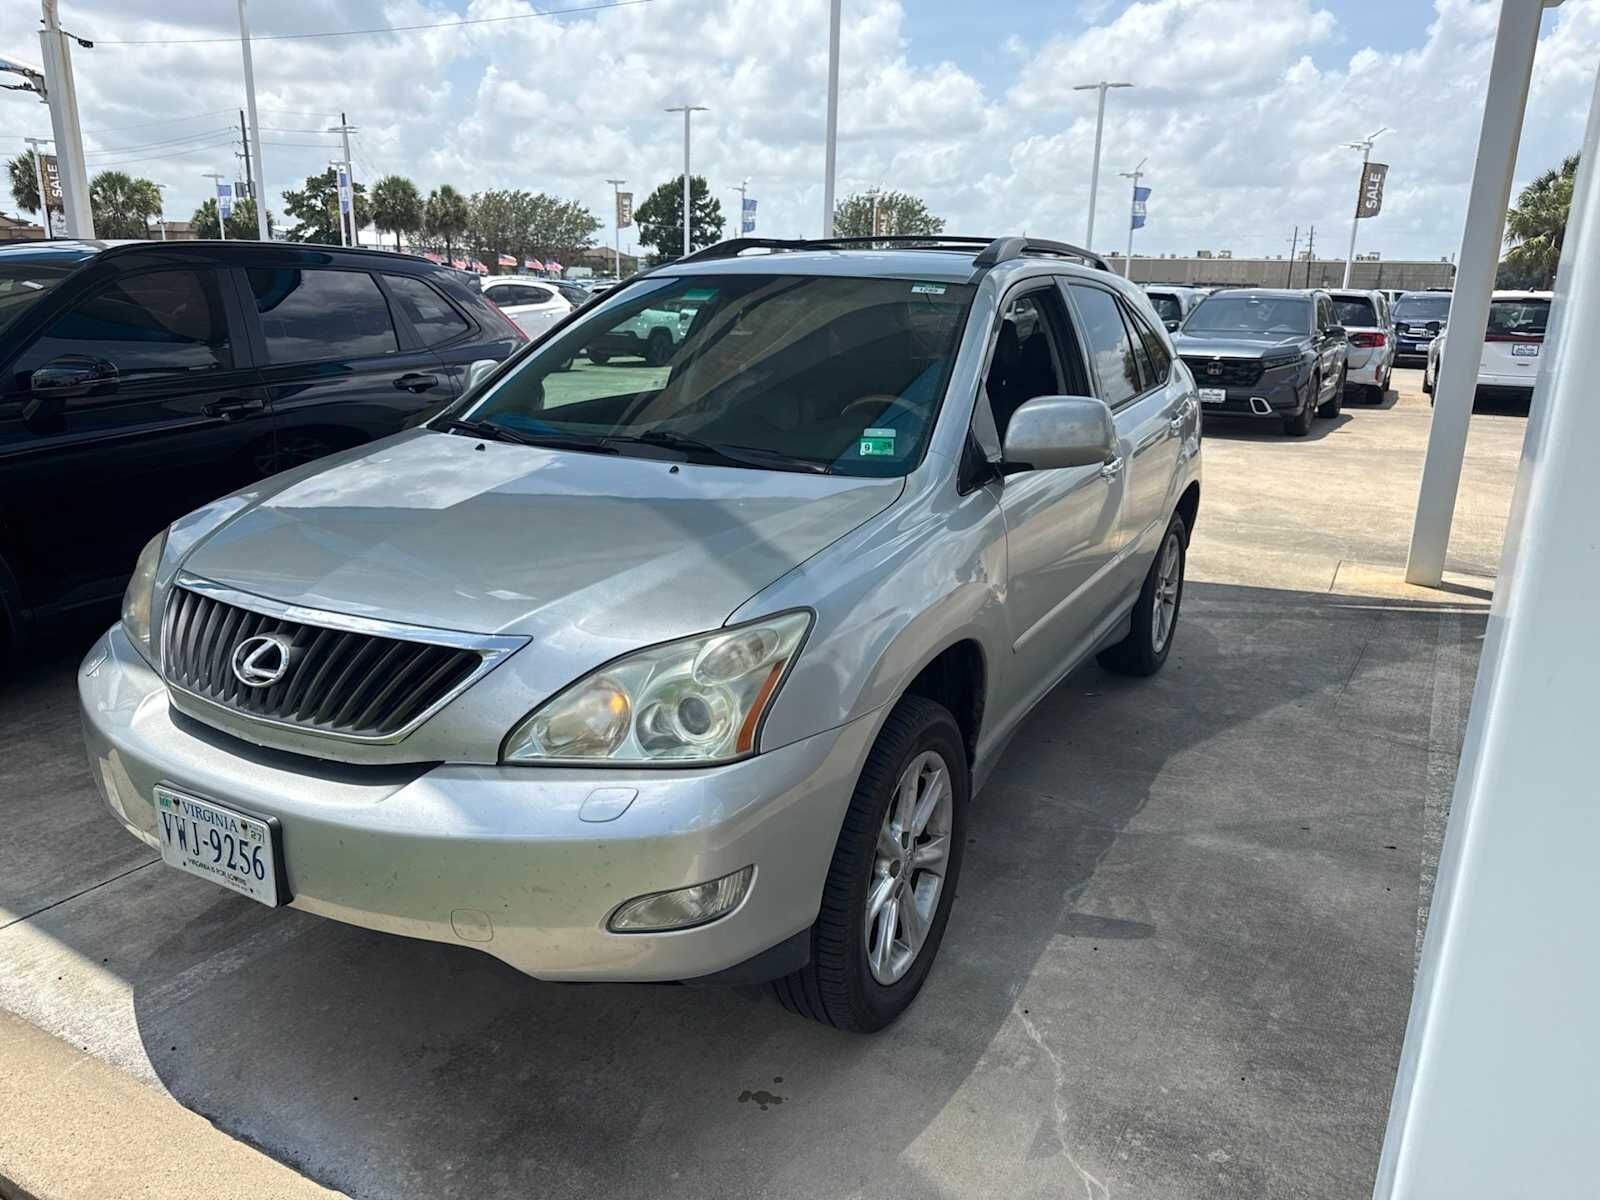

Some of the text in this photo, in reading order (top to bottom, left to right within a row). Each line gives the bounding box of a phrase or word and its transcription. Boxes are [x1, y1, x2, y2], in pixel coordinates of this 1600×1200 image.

[47, 163, 62, 197] SALE
[1366, 172, 1381, 208] SALE
[182, 801, 238, 833] VIRGINIA
[162, 811, 265, 881] VWJ-9256
